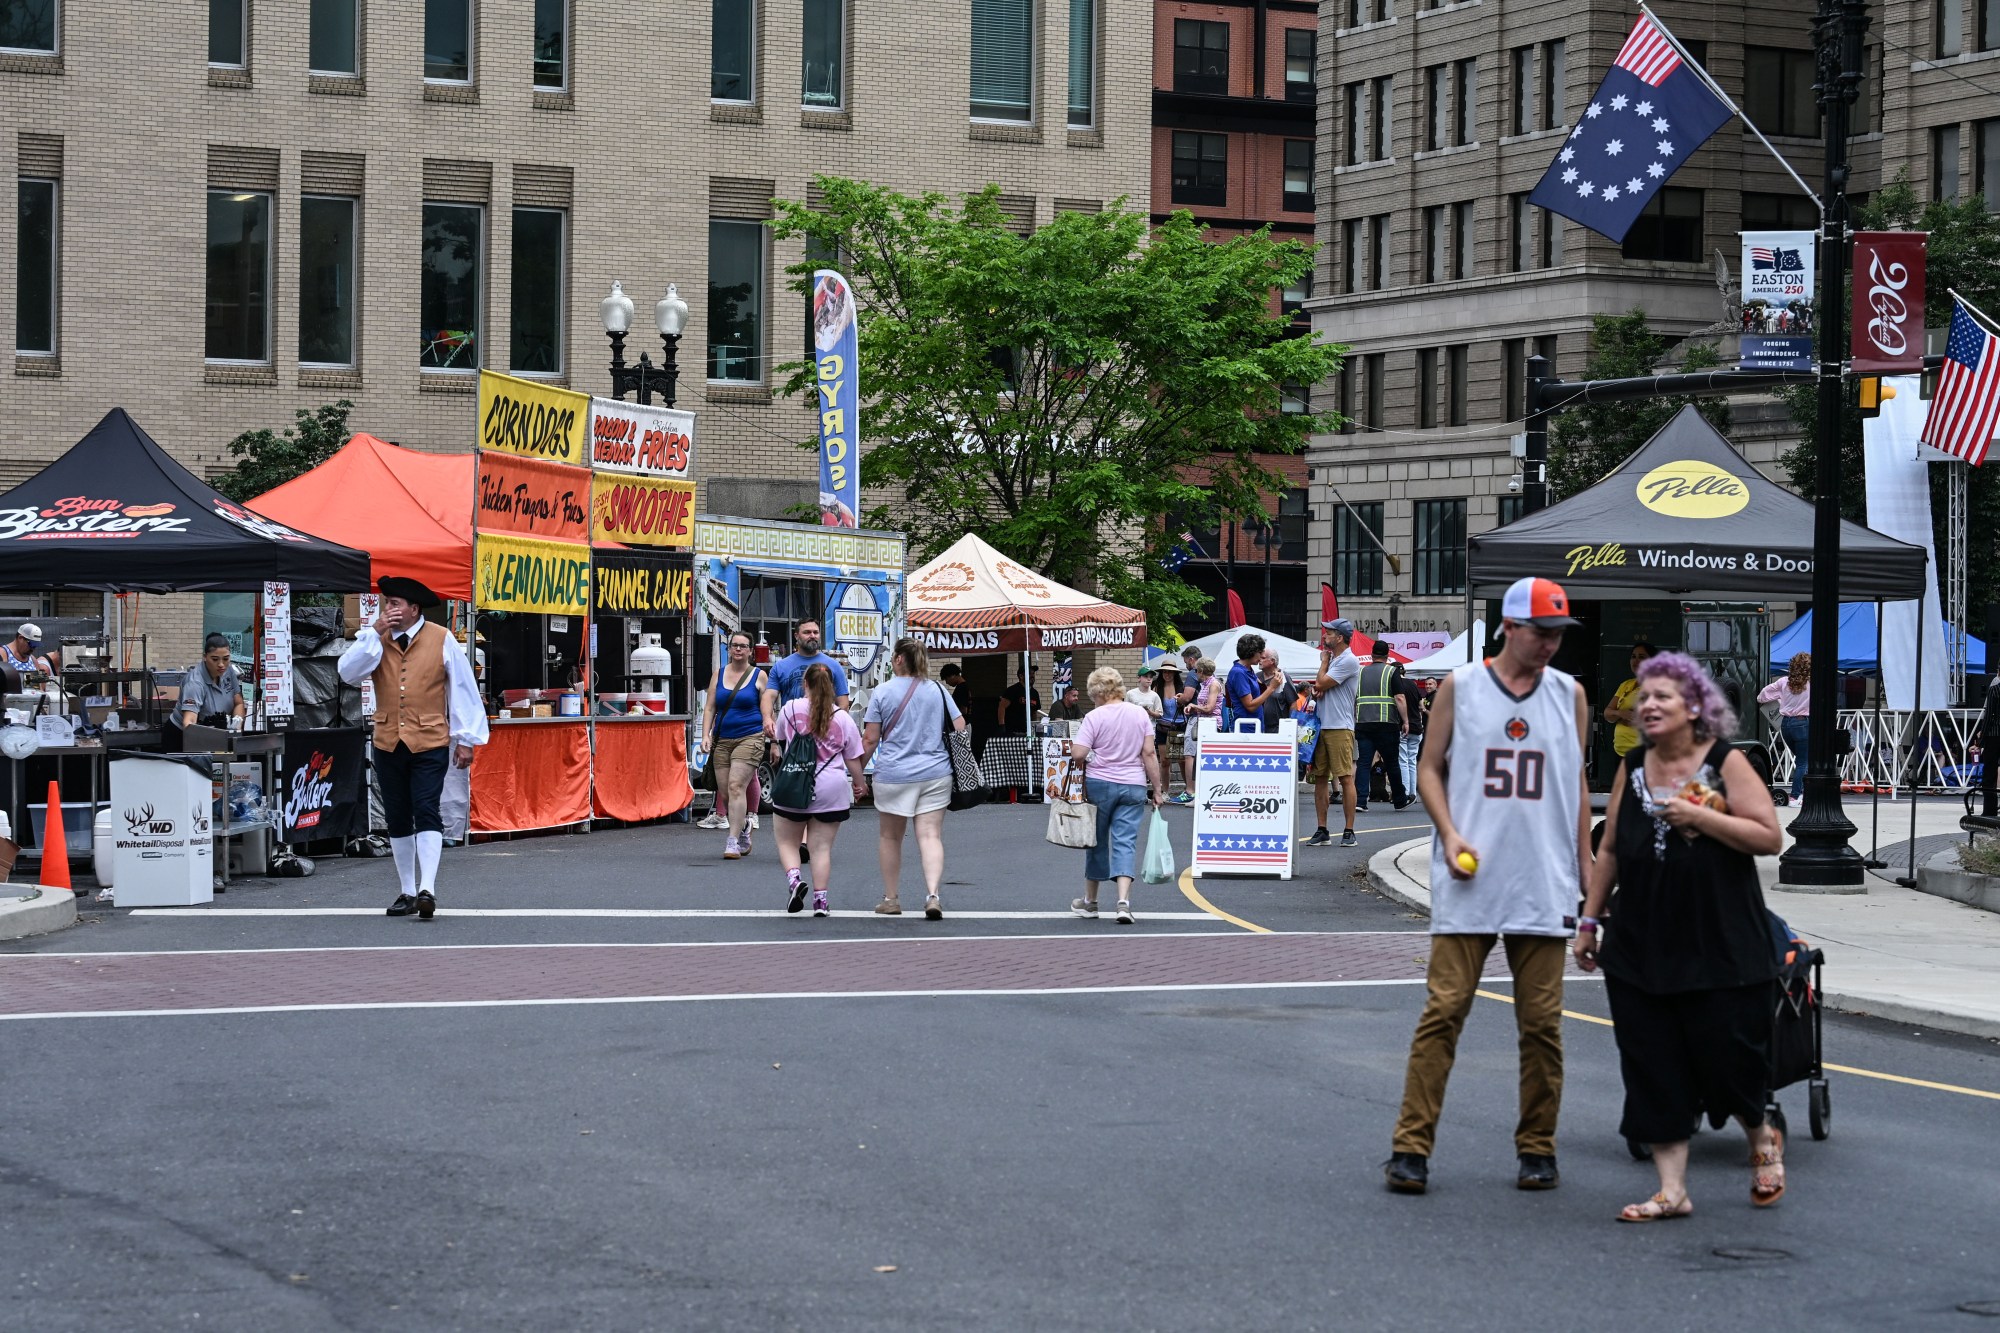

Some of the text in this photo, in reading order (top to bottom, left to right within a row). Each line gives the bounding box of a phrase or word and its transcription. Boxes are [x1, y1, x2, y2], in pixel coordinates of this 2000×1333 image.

[1752, 274, 1804, 285] EASTON
[1784, 286, 1804, 294] 250
[1868, 248, 1908, 355] 200
[628, 421, 637, 443] &
[593, 439, 636, 466] HEDDAR
[638, 430, 690, 472] FRIES
[1644, 475, 1739, 503] Pella
[40, 496, 123, 517] Bun
[513, 483, 550, 530] Fingers
[561, 490, 586, 529] Fries
[604, 484, 692, 536] SMOOTHIE
[1565, 542, 1625, 576] Pella
[1638, 549, 1736, 570] Windows
[1743, 552, 1760, 570] &
[493, 553, 590, 606] LEMONADE
[597, 567, 692, 611] FUNNEL CAKE
[840, 615, 877, 636] GREEK
[1353, 620, 1436, 632] ALPHA BUILDING
[1041, 627, 1134, 647] BAKED EMPANADAS
[849, 647, 869, 657] STREET
[1484, 748, 1545, 801] 50
[1209, 782, 1241, 800] Pella
[1239, 797, 1287, 814] 250th
[149, 822, 172, 833] WD
